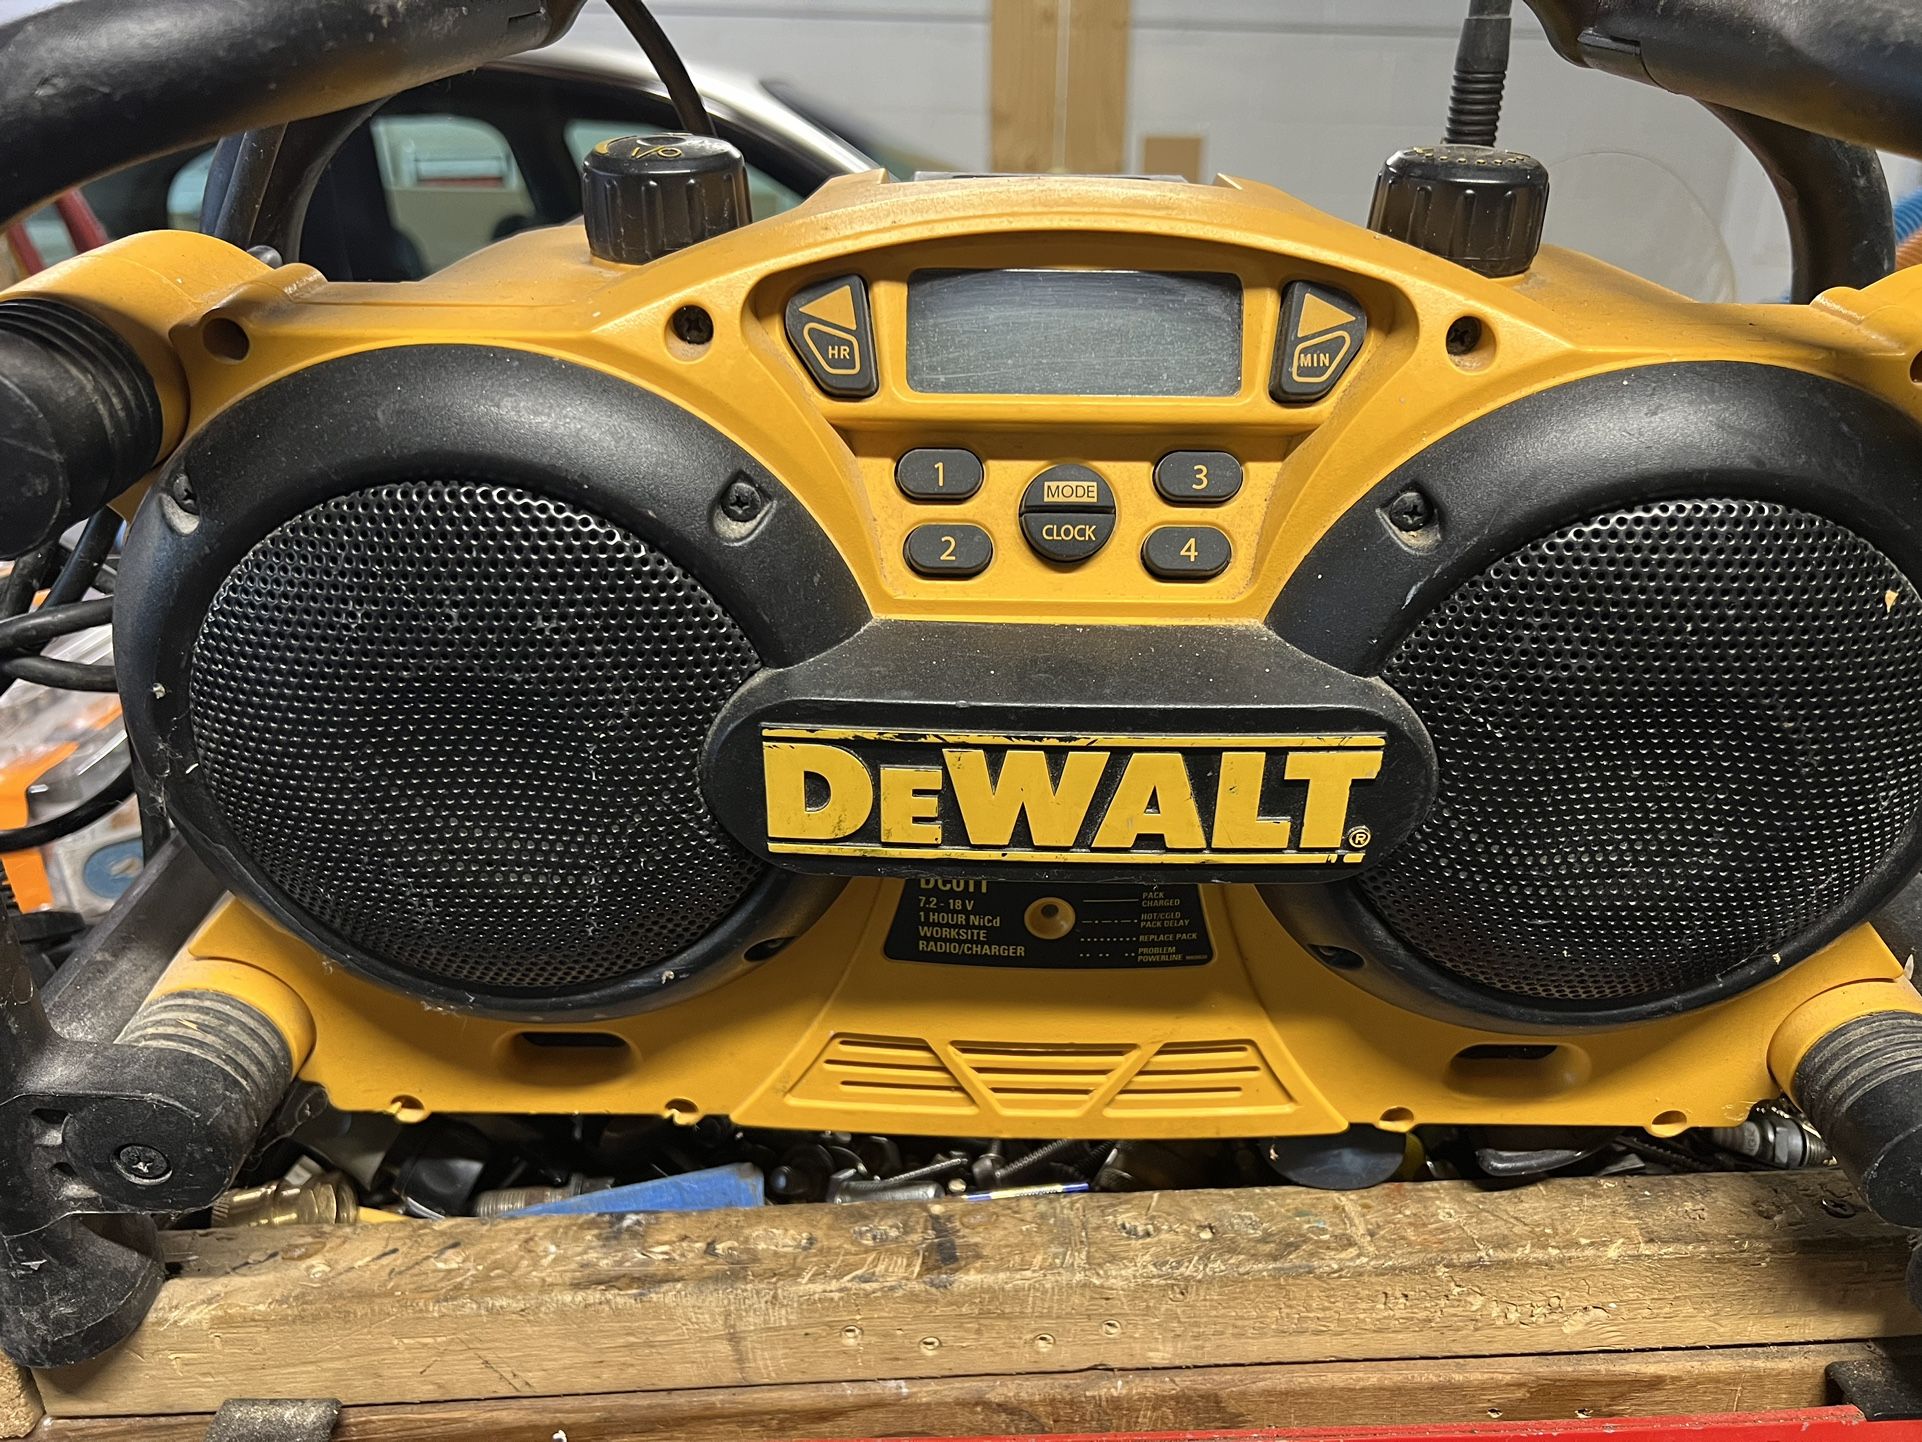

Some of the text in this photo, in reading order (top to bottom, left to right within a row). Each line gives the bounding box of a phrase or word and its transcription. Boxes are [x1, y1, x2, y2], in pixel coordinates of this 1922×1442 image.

[827, 344, 851, 361] HR
[1299, 352, 1331, 368] MIN
[934, 462, 946, 487] 1
[1193, 465, 1208, 490] 3
[1046, 484, 1096, 499] MODE
[1042, 524, 1097, 541] CLOCK
[940, 537, 956, 561] 2
[1179, 538, 1199, 562] 4
[918, 896, 937, 909] 7.2
[948, 899, 962, 911] 18
[965, 899, 975, 911] V
[1141, 899, 1180, 907] CHARGED
[919, 911, 1000, 928] 1 HOUR NiCd
[1140, 919, 1190, 929] PACK DELAY
[918, 925, 988, 941] WORKSITE
[1139, 932, 1198, 942] REPLACE PACK
[918, 940, 1026, 957] RADIO/CHARGER
[1138, 946, 1176, 954] PROBLEM
